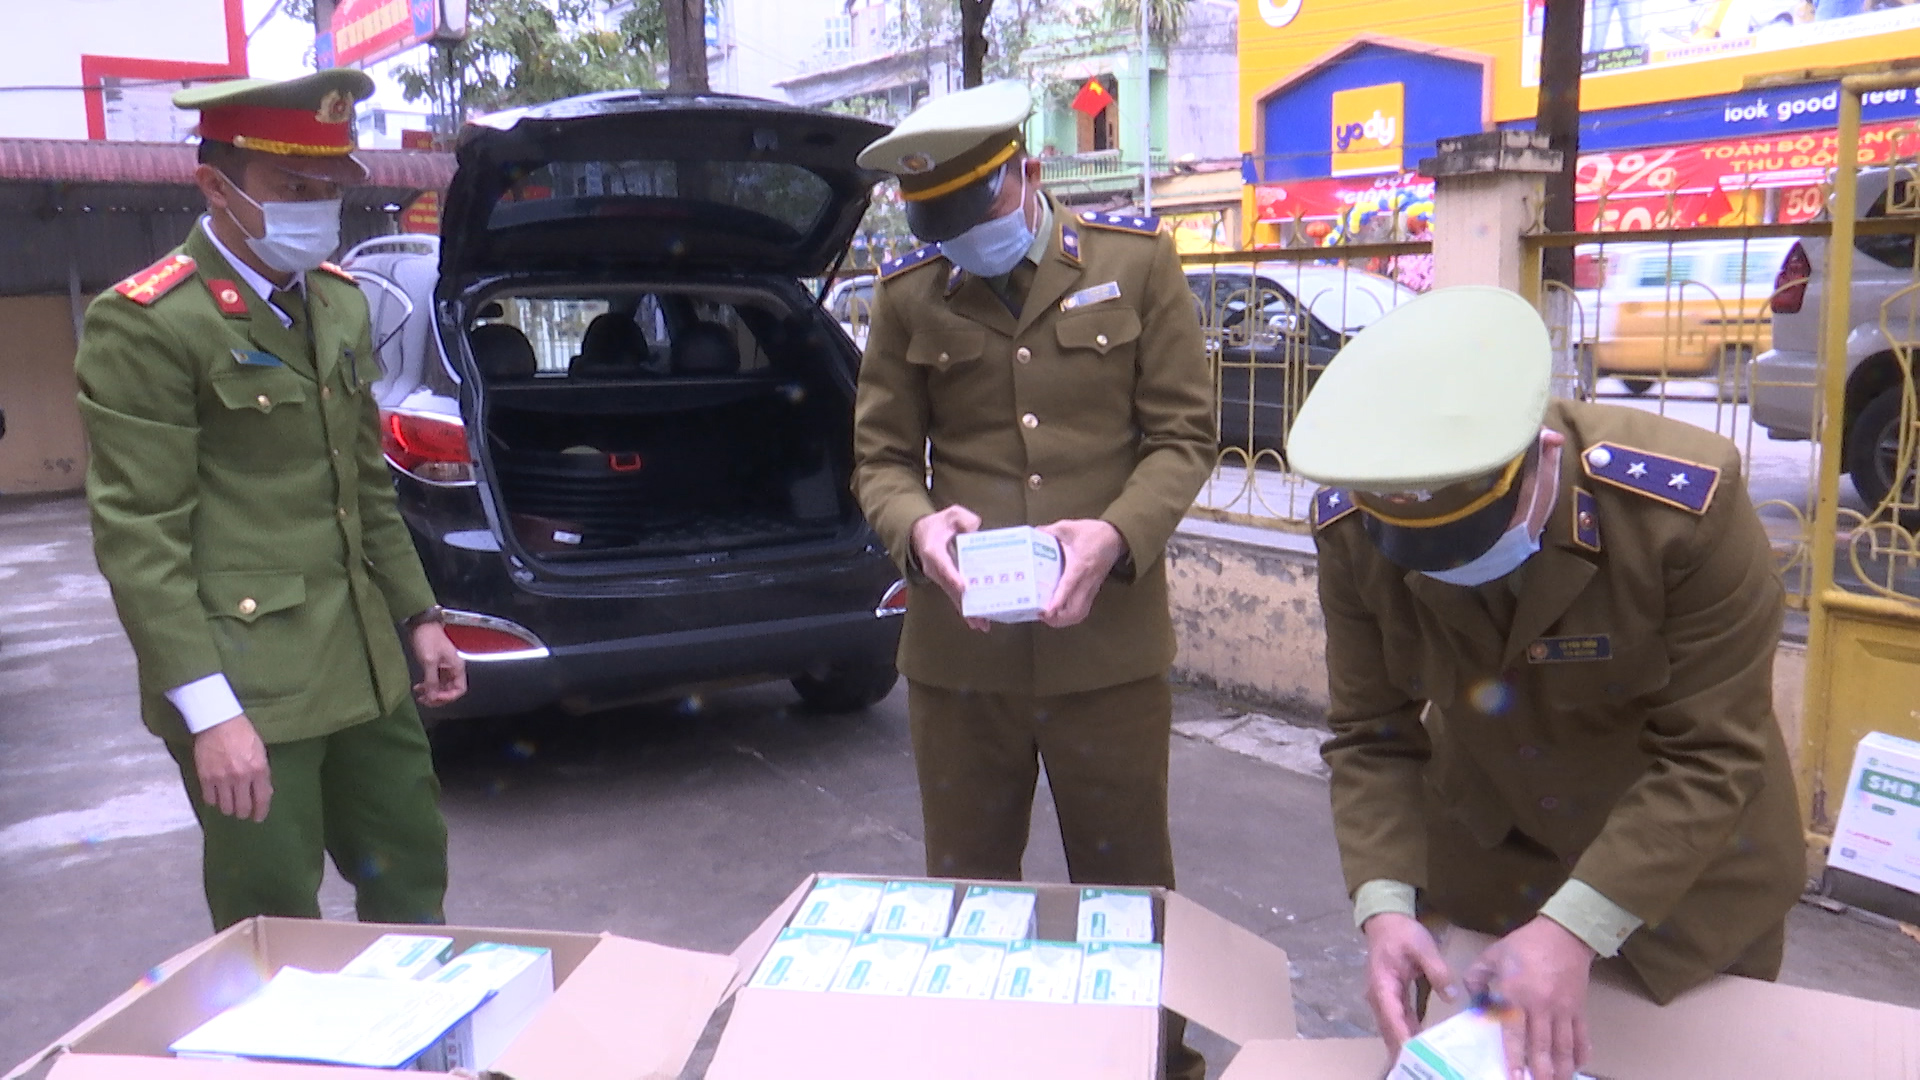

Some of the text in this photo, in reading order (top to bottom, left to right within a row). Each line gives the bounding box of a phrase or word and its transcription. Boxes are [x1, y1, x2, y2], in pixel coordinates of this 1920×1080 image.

[1666, 39, 1750, 60] EVERYDAY WEAR
[1777, 91, 1837, 121] good
[1336, 110, 1396, 150] yody
[1776, 135, 1815, 154] BỘ
[1823, 128, 1903, 148] HNG
[1730, 157, 1784, 173] THU
